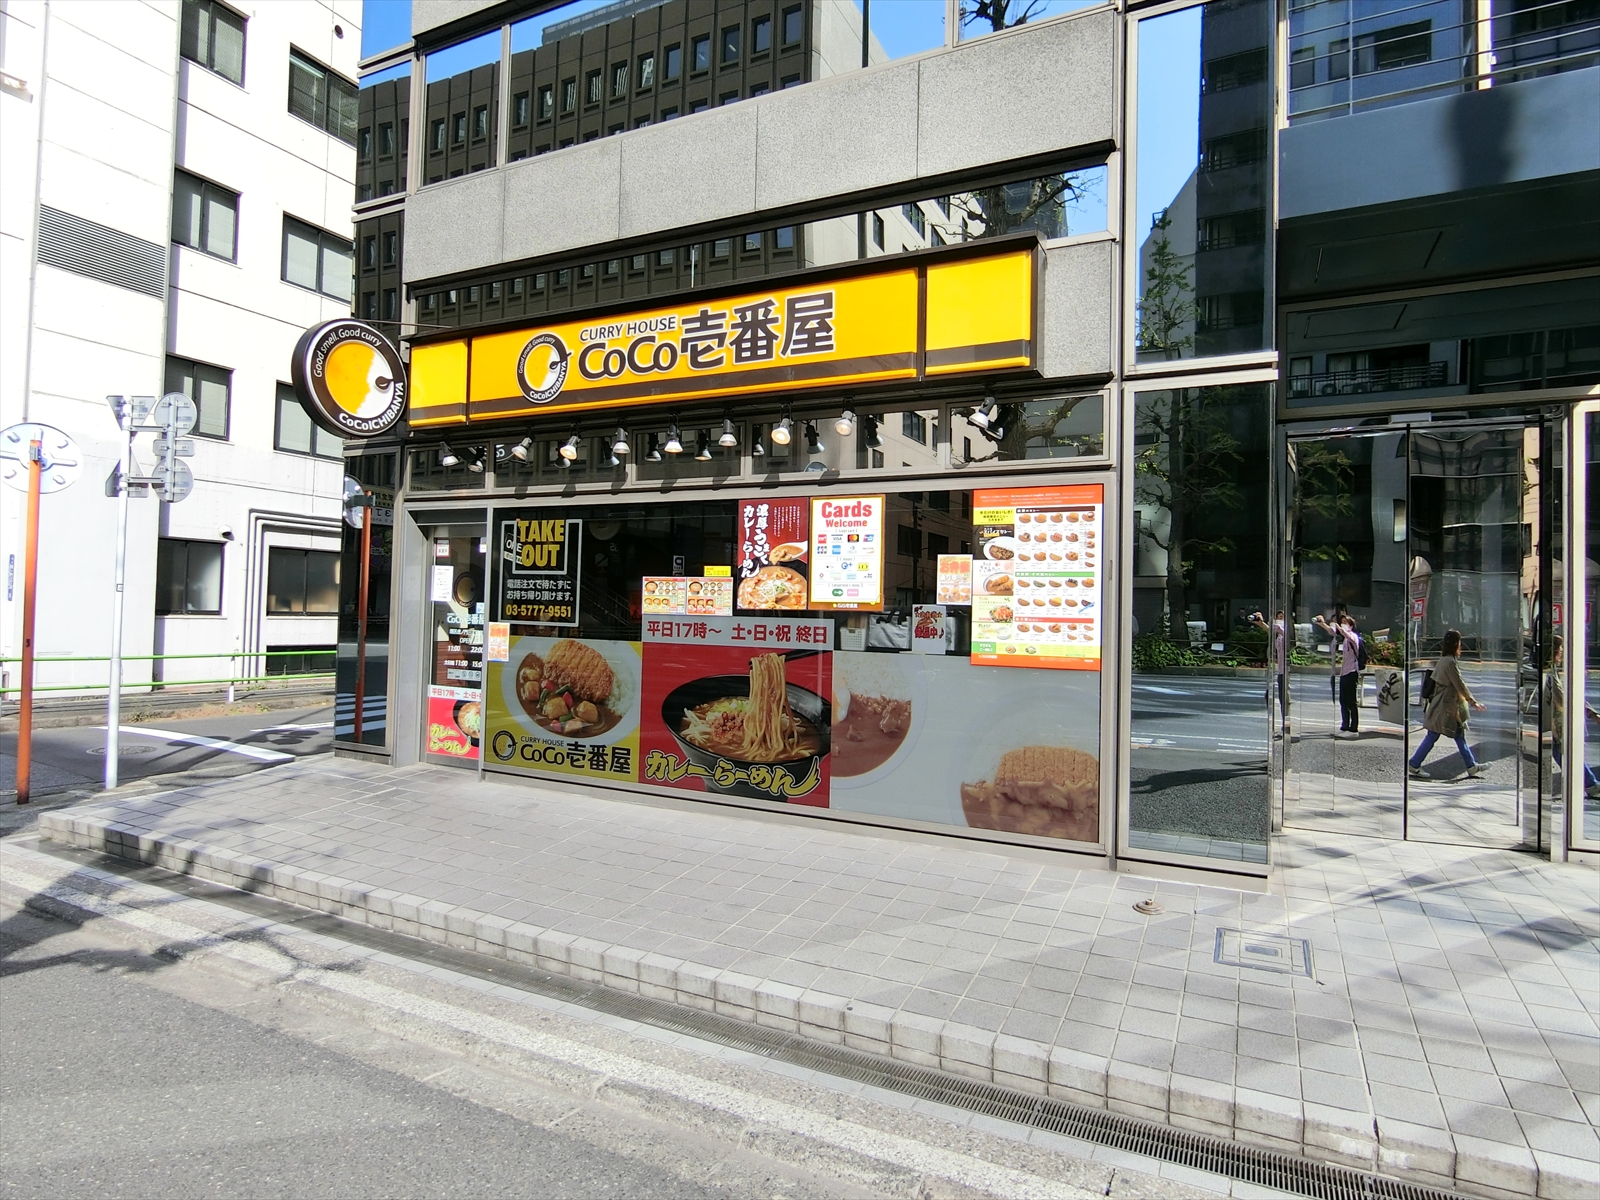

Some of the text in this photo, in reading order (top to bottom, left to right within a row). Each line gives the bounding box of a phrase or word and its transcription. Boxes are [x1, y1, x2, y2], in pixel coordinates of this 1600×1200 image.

[580, 317, 676, 342] CURRY HOUSE
[532, 336, 544, 346] Good
[314, 328, 382, 378] Good smell. Good curry
[822, 501, 872, 518] Cards
[518, 520, 564, 542] TAKE
[826, 520, 868, 528] Welcome
[522, 544, 560, 567] OUT
[506, 579, 572, 590] 電話注文で待たずに
[506, 590, 574, 602] お持ち帰り頂けます。
[506, 604, 572, 618] 03-5777-9551
[731, 623, 791, 642] 土・日・祝
[796, 625, 827, 644] 終日
[542, 738, 564, 746] HOUSE
[646, 750, 820, 797] カレーらーめん
